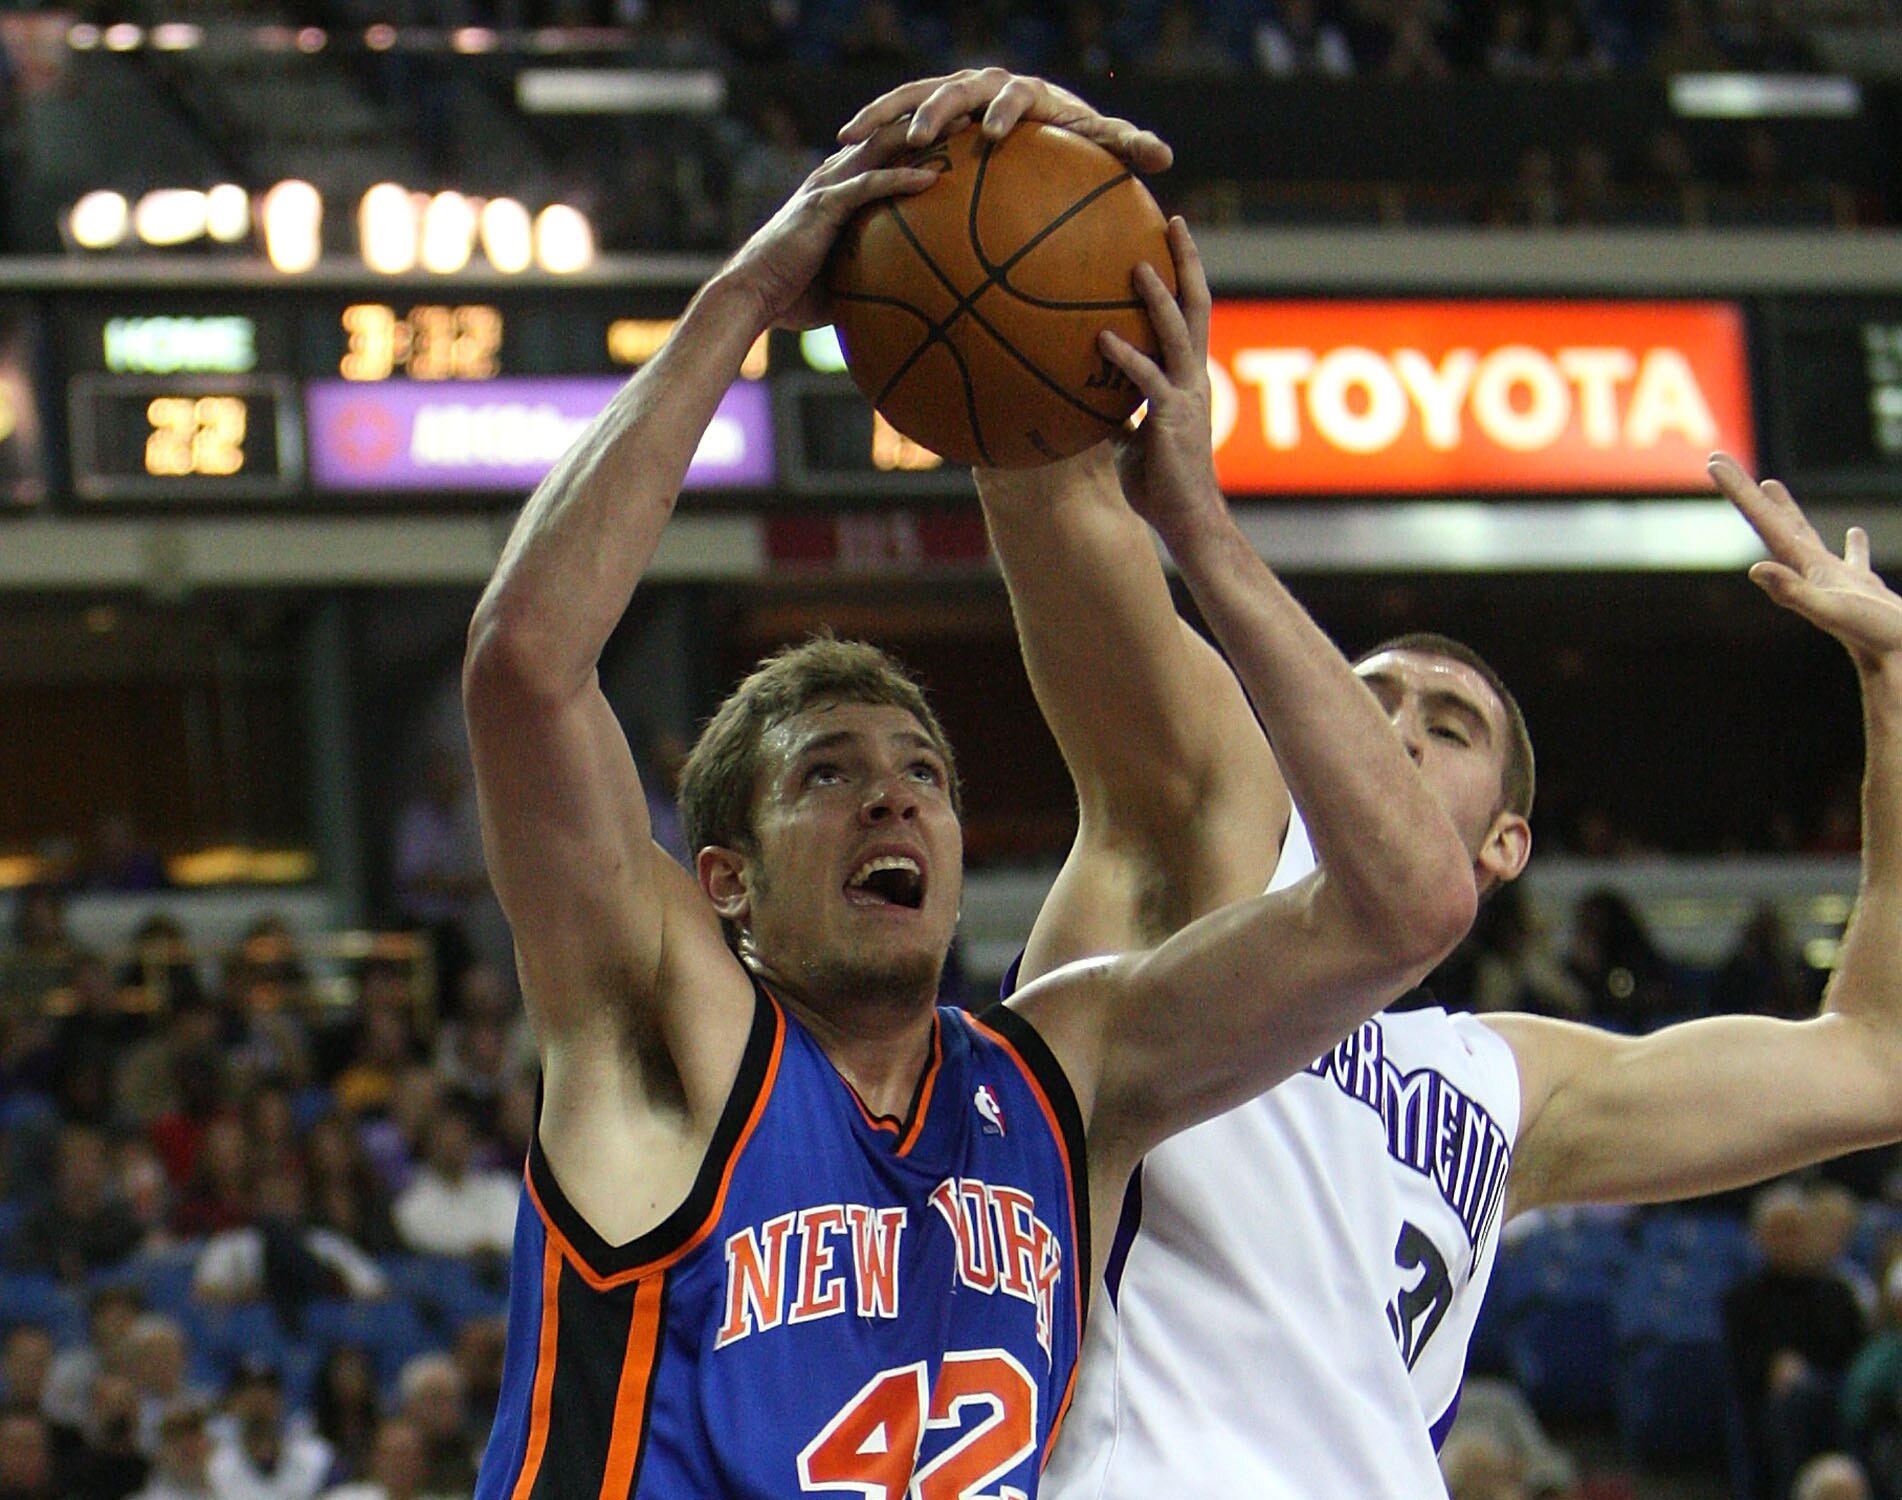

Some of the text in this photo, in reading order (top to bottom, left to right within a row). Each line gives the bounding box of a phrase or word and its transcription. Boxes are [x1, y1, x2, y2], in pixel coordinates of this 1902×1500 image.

[145, 396, 247, 477] 22
[1233, 345, 1720, 453] TOYOTA
[714, 1204, 907, 1350] NEW
